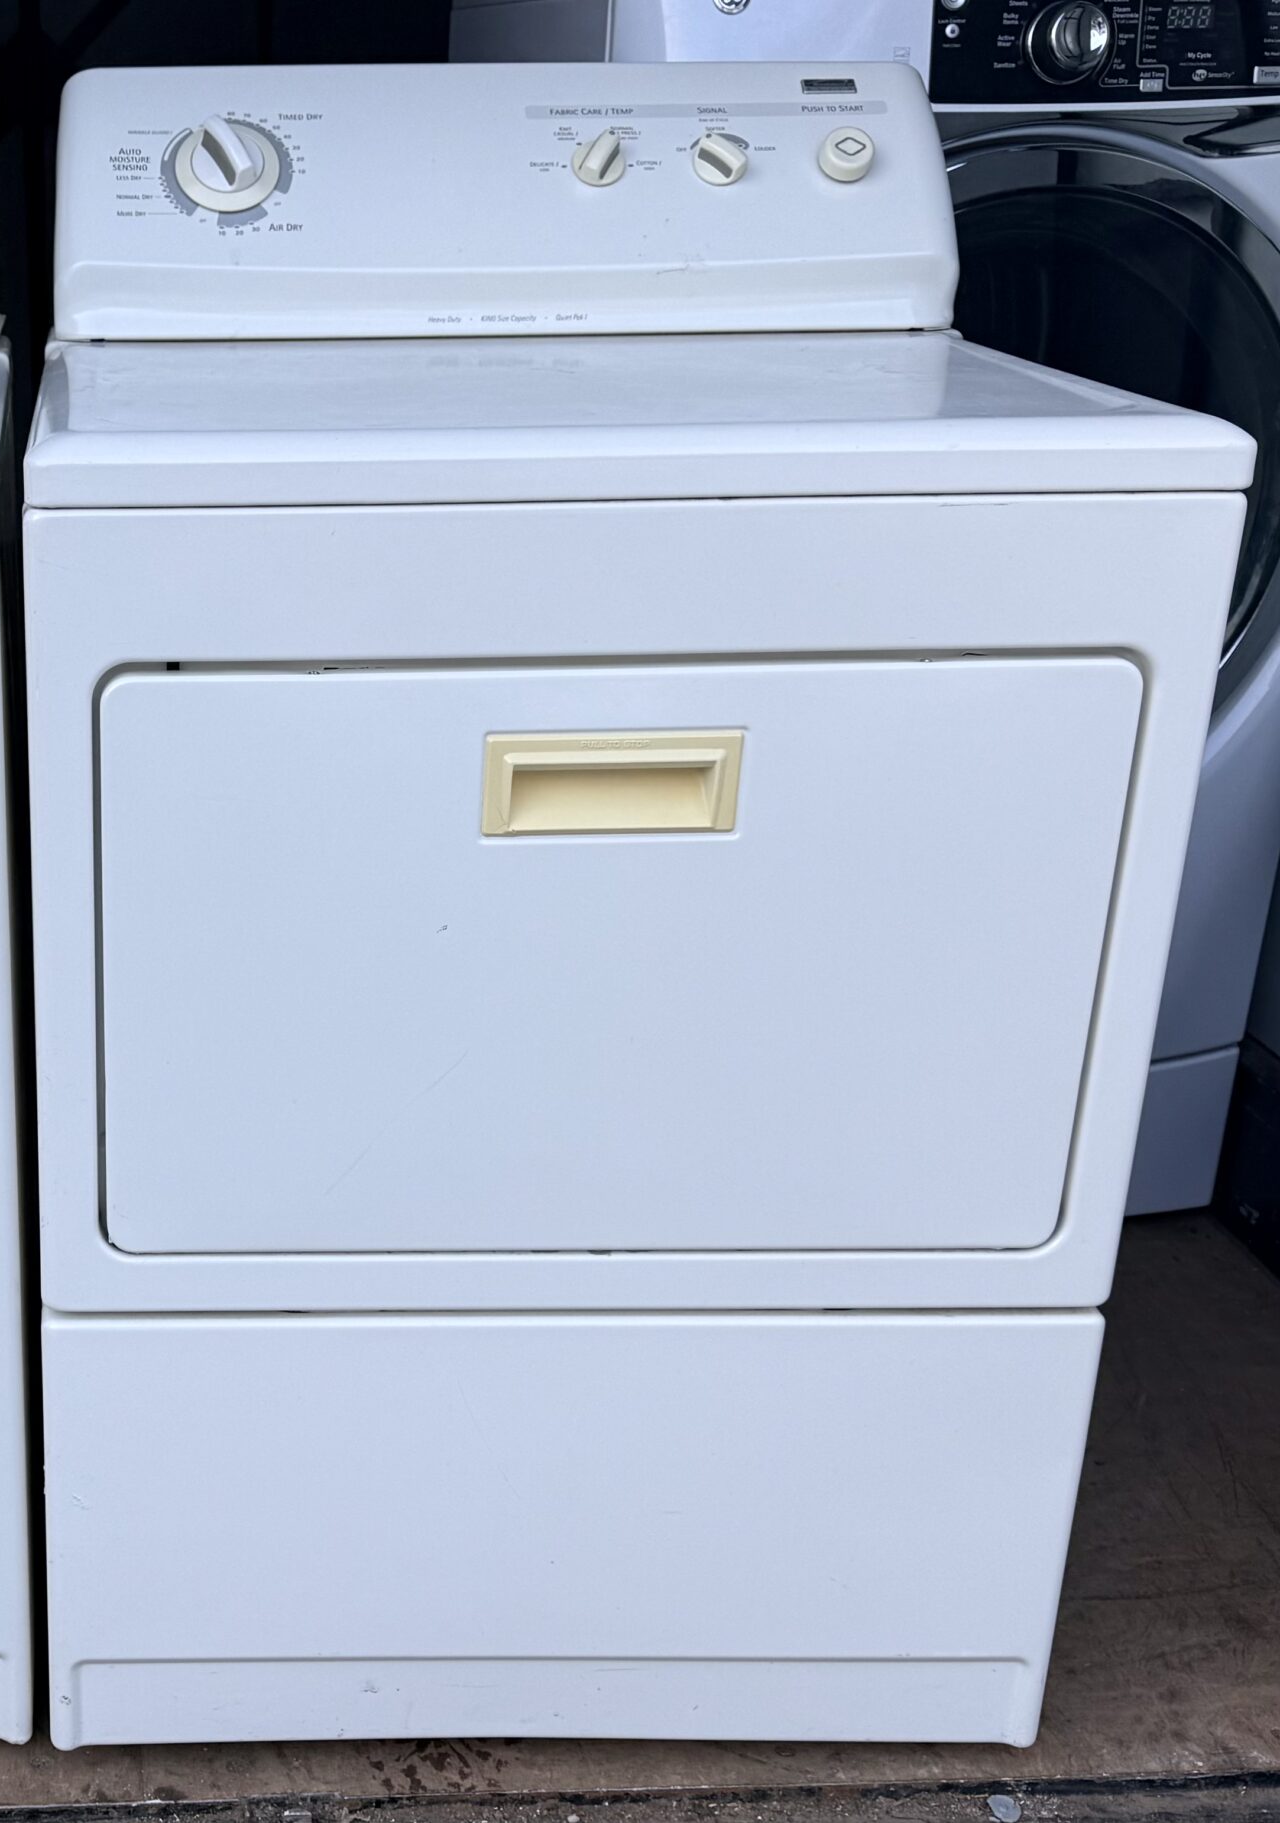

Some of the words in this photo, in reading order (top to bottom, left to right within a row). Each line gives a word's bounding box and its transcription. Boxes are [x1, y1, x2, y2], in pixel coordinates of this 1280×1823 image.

[1196, 51, 1212, 59] Cycle
[1261, 70, 1279, 79] Temp
[549, 108, 579, 116] FABRIC
[581, 107, 602, 116] CARE
[611, 107, 634, 115] TEMP
[118, 147, 142, 156] AUTO
[109, 156, 151, 164] MOISTURE
[268, 223, 284, 232] AIR
[286, 223, 304, 232] DRY
